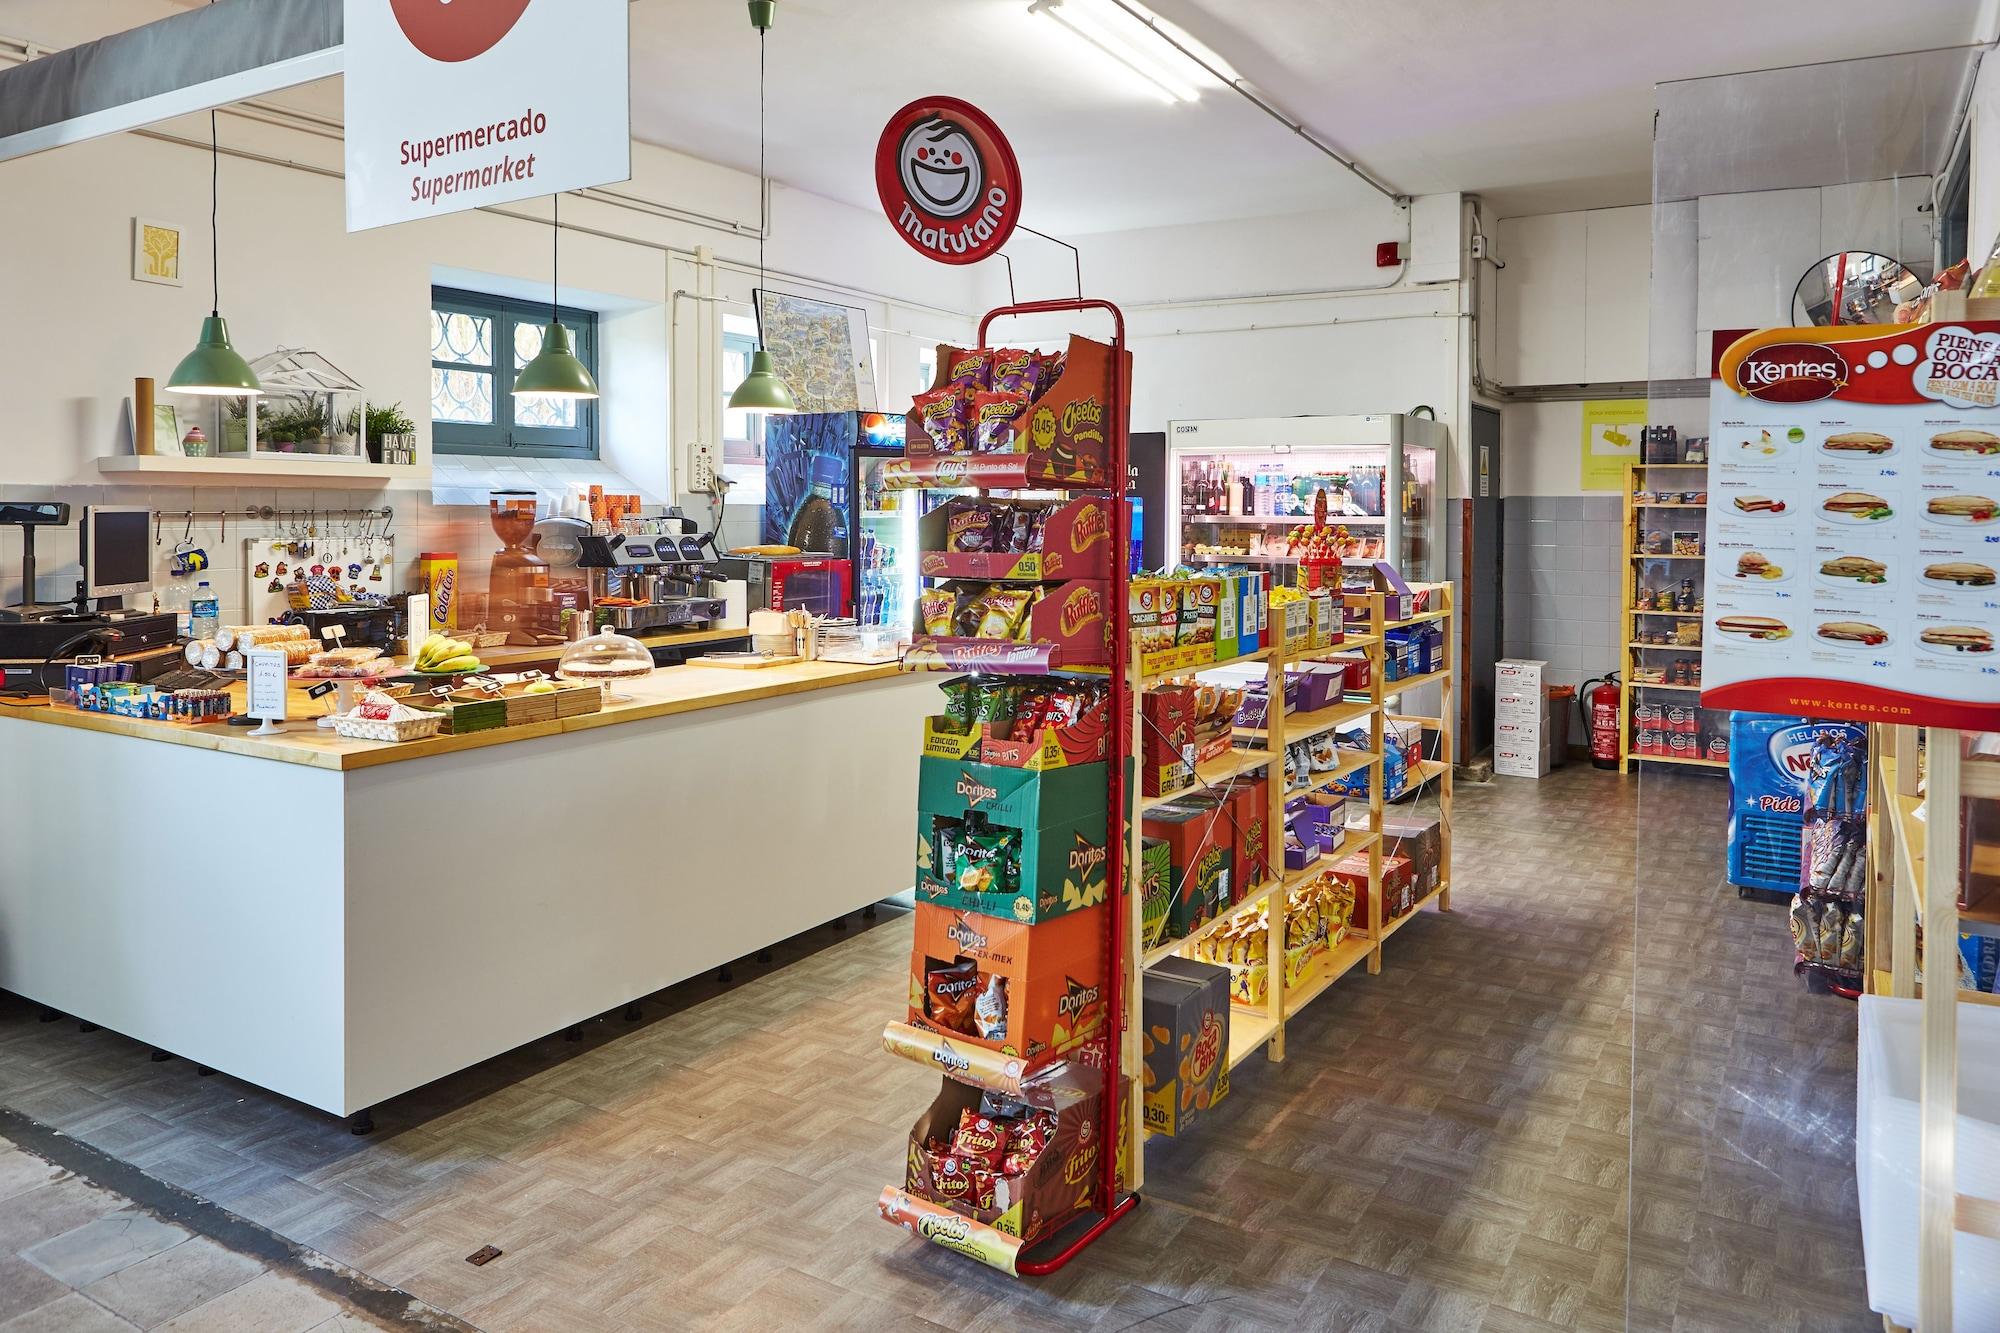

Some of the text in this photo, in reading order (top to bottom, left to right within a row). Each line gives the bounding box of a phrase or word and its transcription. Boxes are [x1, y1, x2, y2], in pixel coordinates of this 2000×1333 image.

[400, 108, 547, 167] Supermercado
[411, 153, 536, 205] Supermarket
[1934, 347, 1973, 363] CON
[952, 357, 983, 380] Cheetos
[1747, 359, 1837, 385] Kentes
[1928, 362, 1999, 380] BOCA
[980, 401, 1017, 424] Cheetos
[1062, 396, 1102, 437] Cheetos
[384, 434, 416, 449] HAVE
[1073, 429, 1104, 444] Pandilla
[384, 450, 415, 464] FUN!
[951, 512, 990, 527] Ruffles
[1075, 511, 1107, 546] Ruffles
[1064, 593, 1100, 627] Ruffles
[1790, 696, 1912, 715] www.kentes.com
[1045, 711, 1065, 723] BITS
[930, 736, 959, 747] EDICIÓN
[1169, 722, 1187, 747] BITS
[925, 743, 961, 755] LIMITADA
[1002, 749, 1019, 762] BITS
[956, 780, 998, 800] Doritos
[1161, 776, 1185, 793] GRATIS
[1760, 796, 1800, 812] Pide
[1069, 845, 1107, 870] Doritos
[920, 879, 949, 895] Doritos
[1142, 872, 1160, 903] ITS
[948, 926, 987, 947] Doritos
[936, 975, 977, 994] Doritos
[1059, 986, 1099, 1015] Doritos
[934, 1049, 969, 1070] Doritos
[919, 1213, 970, 1241] Cheetos
